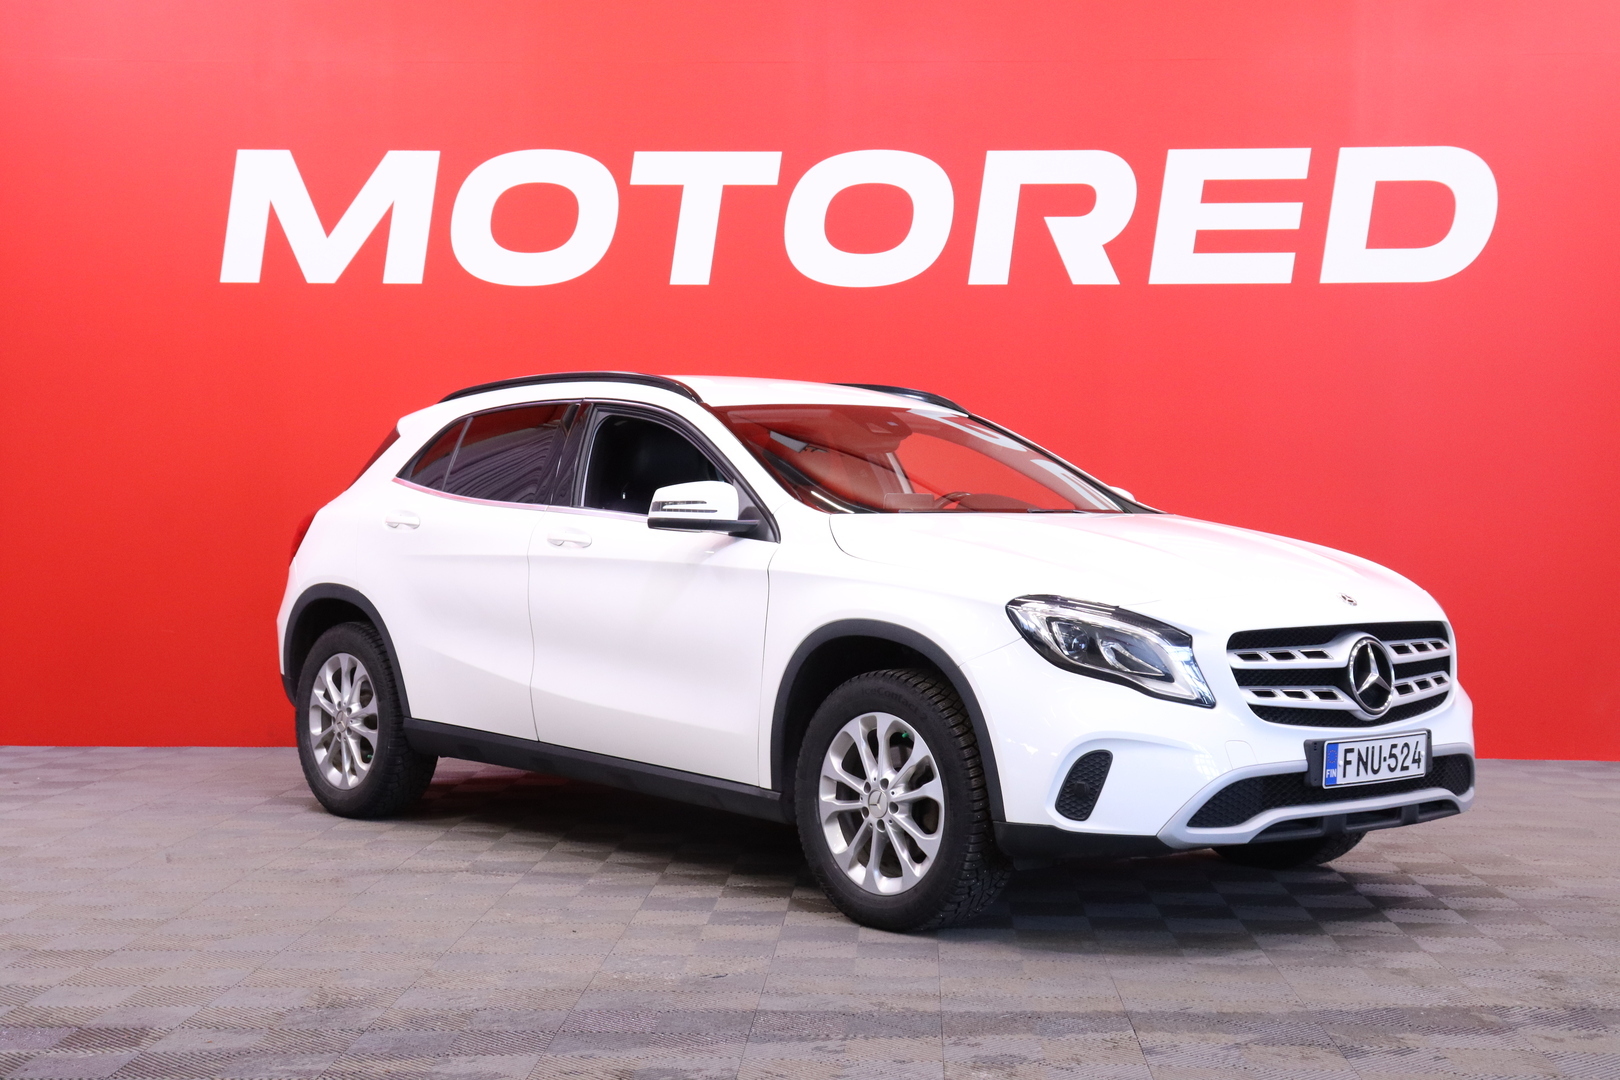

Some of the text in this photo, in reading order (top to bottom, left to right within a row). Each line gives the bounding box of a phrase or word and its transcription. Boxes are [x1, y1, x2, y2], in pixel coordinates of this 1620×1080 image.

[220, 146, 1498, 287] MOTORED
[1325, 768, 1337, 778] FIN
[1343, 741, 1422, 778] FNU-524
